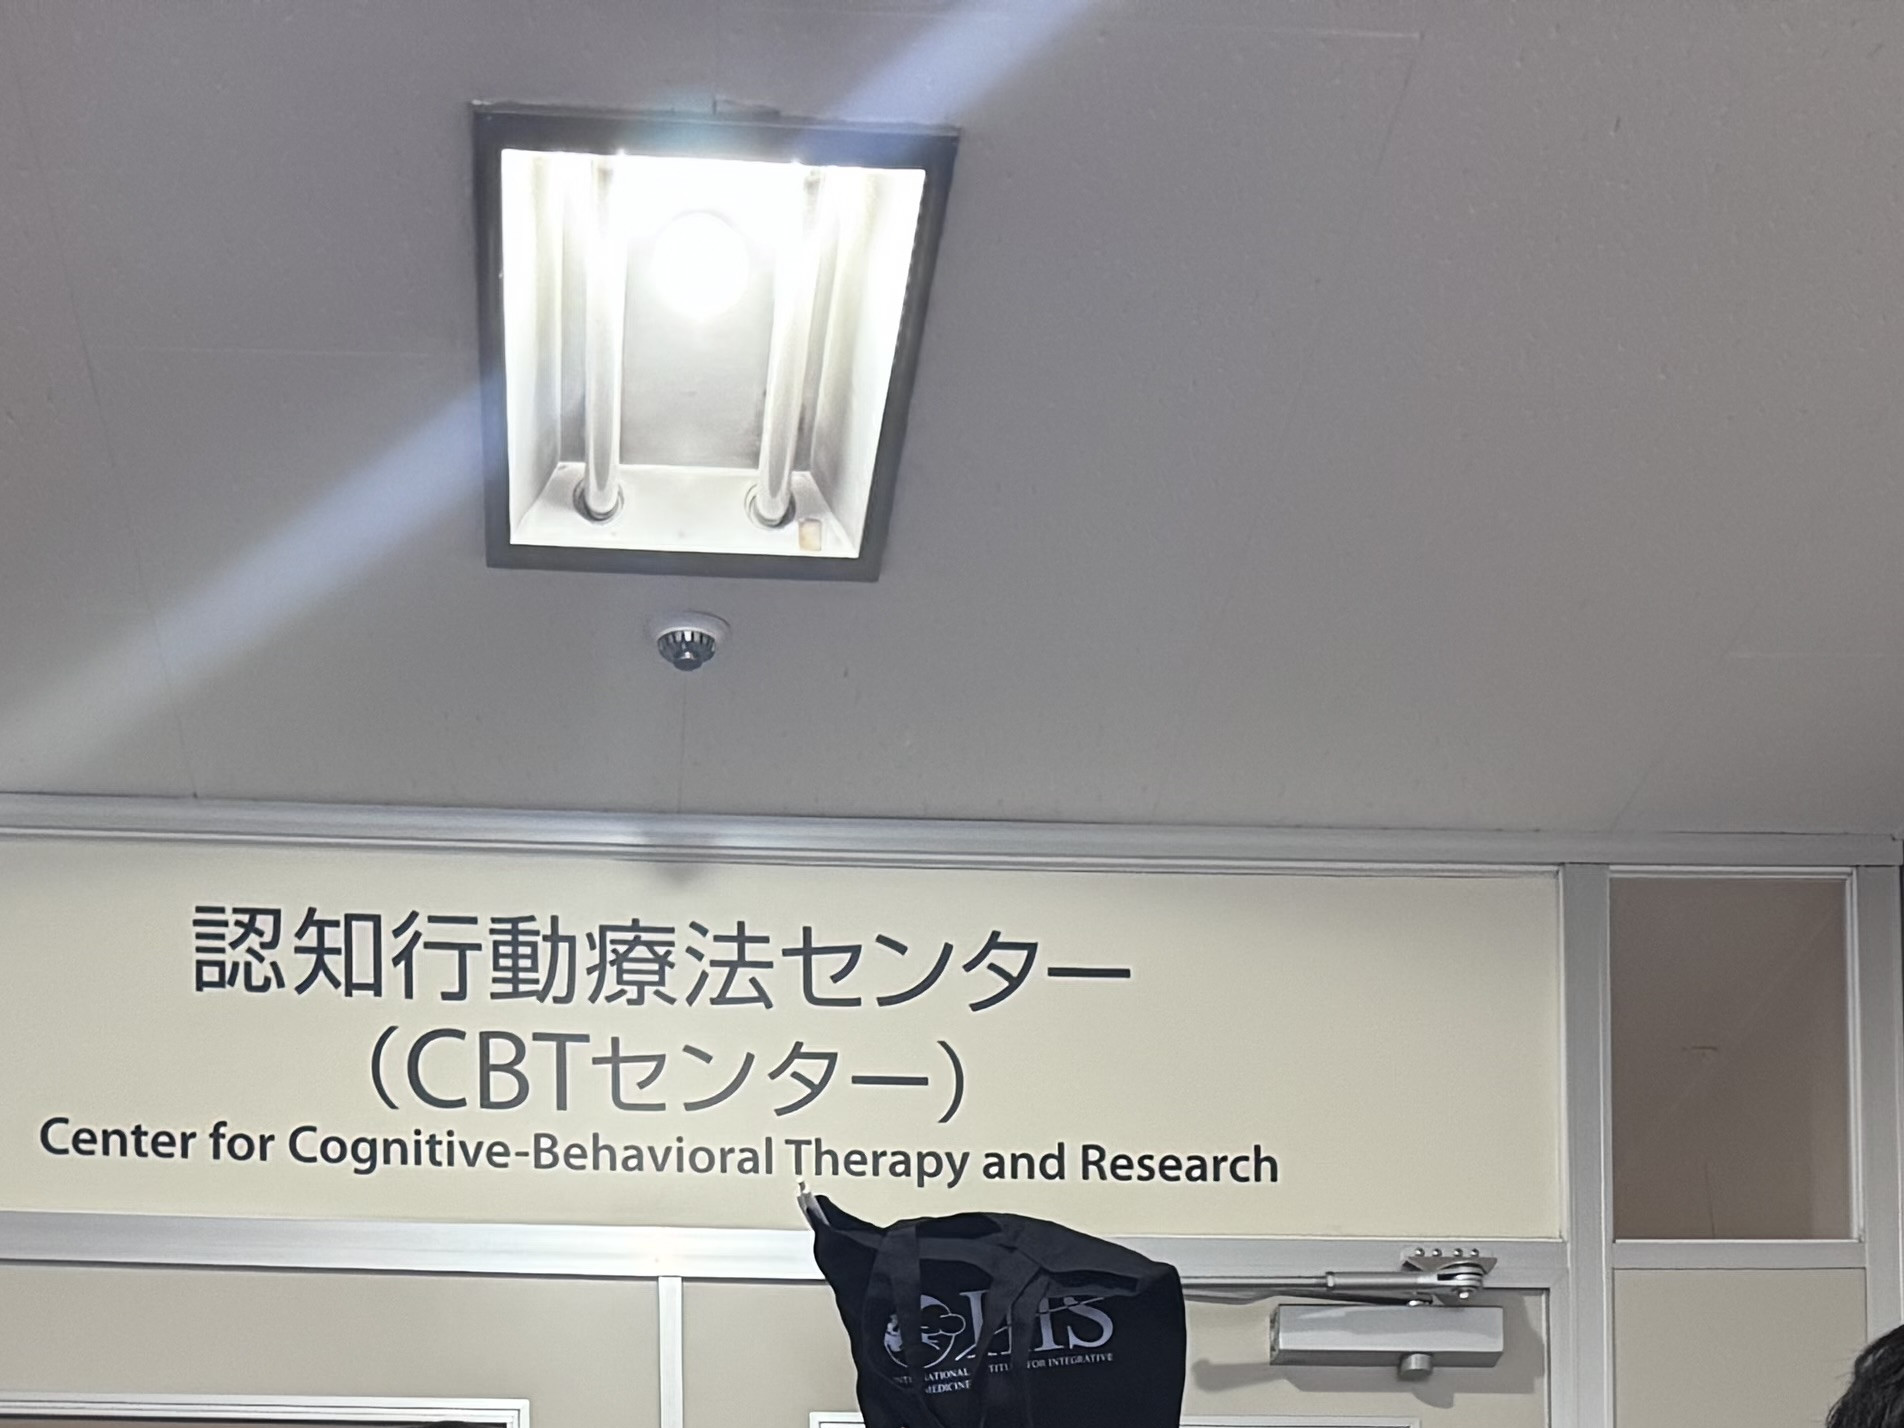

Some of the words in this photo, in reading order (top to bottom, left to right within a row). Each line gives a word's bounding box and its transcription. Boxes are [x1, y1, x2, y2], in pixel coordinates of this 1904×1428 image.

[191, 904, 1133, 1013] 認知行動療法センター
[39, 1116, 198, 1160] Center
[208, 1120, 276, 1162] for
[288, 1125, 773, 1175] Cognitive-Behavioral
[785, 1137, 970, 1188] Therapy
[982, 1141, 1066, 1181] and
[1081, 1143, 1279, 1183] Research
